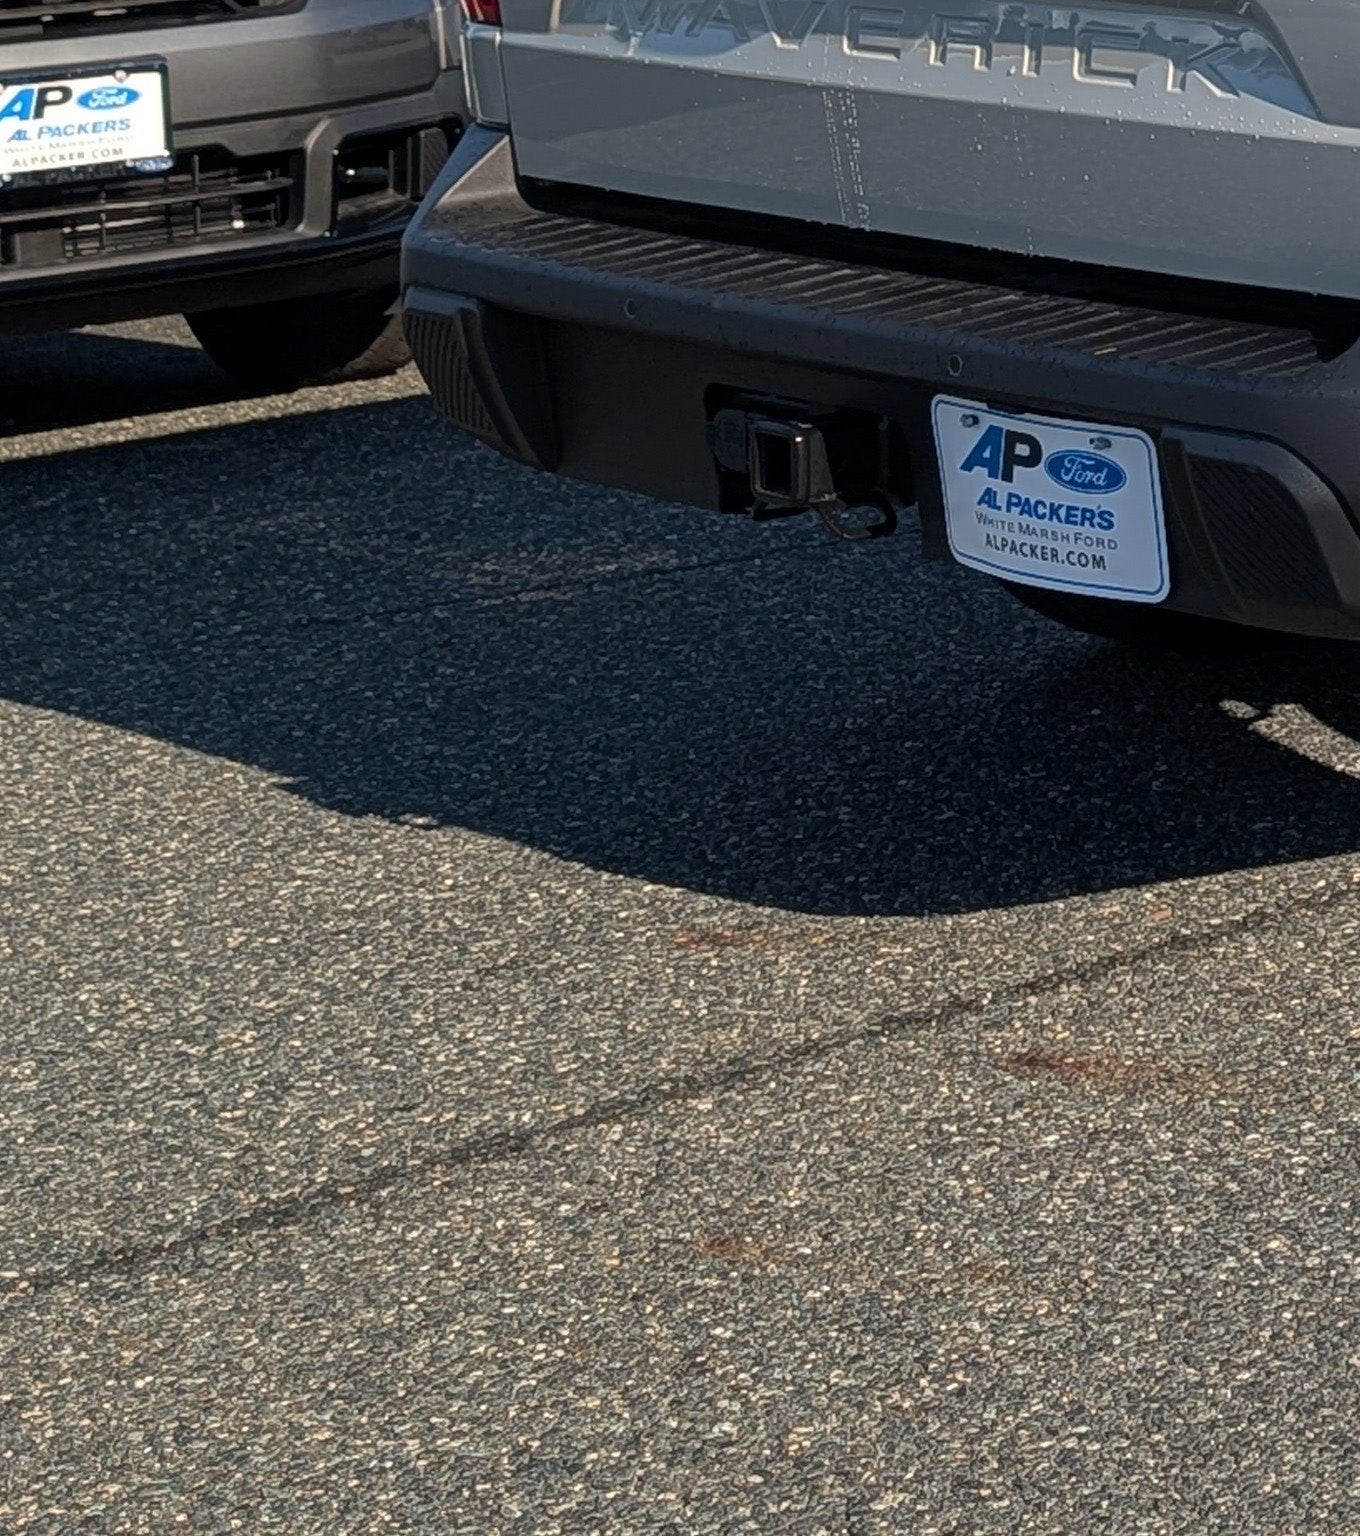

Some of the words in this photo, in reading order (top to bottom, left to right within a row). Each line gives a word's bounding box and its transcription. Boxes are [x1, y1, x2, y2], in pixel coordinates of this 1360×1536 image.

[0, 85, 73, 121] AP
[88, 88, 129, 109] Ford
[959, 424, 1043, 484] AP
[1060, 455, 1109, 486] Ford
[976, 486, 1002, 512] AL
[1005, 492, 1116, 531] PACKER'S
[975, 511, 1016, 534] WHITE
[1018, 520, 1072, 543] MARSH
[1073, 531, 1119, 551] FORD
[985, 533, 1108, 571] ALPACKER.COM
